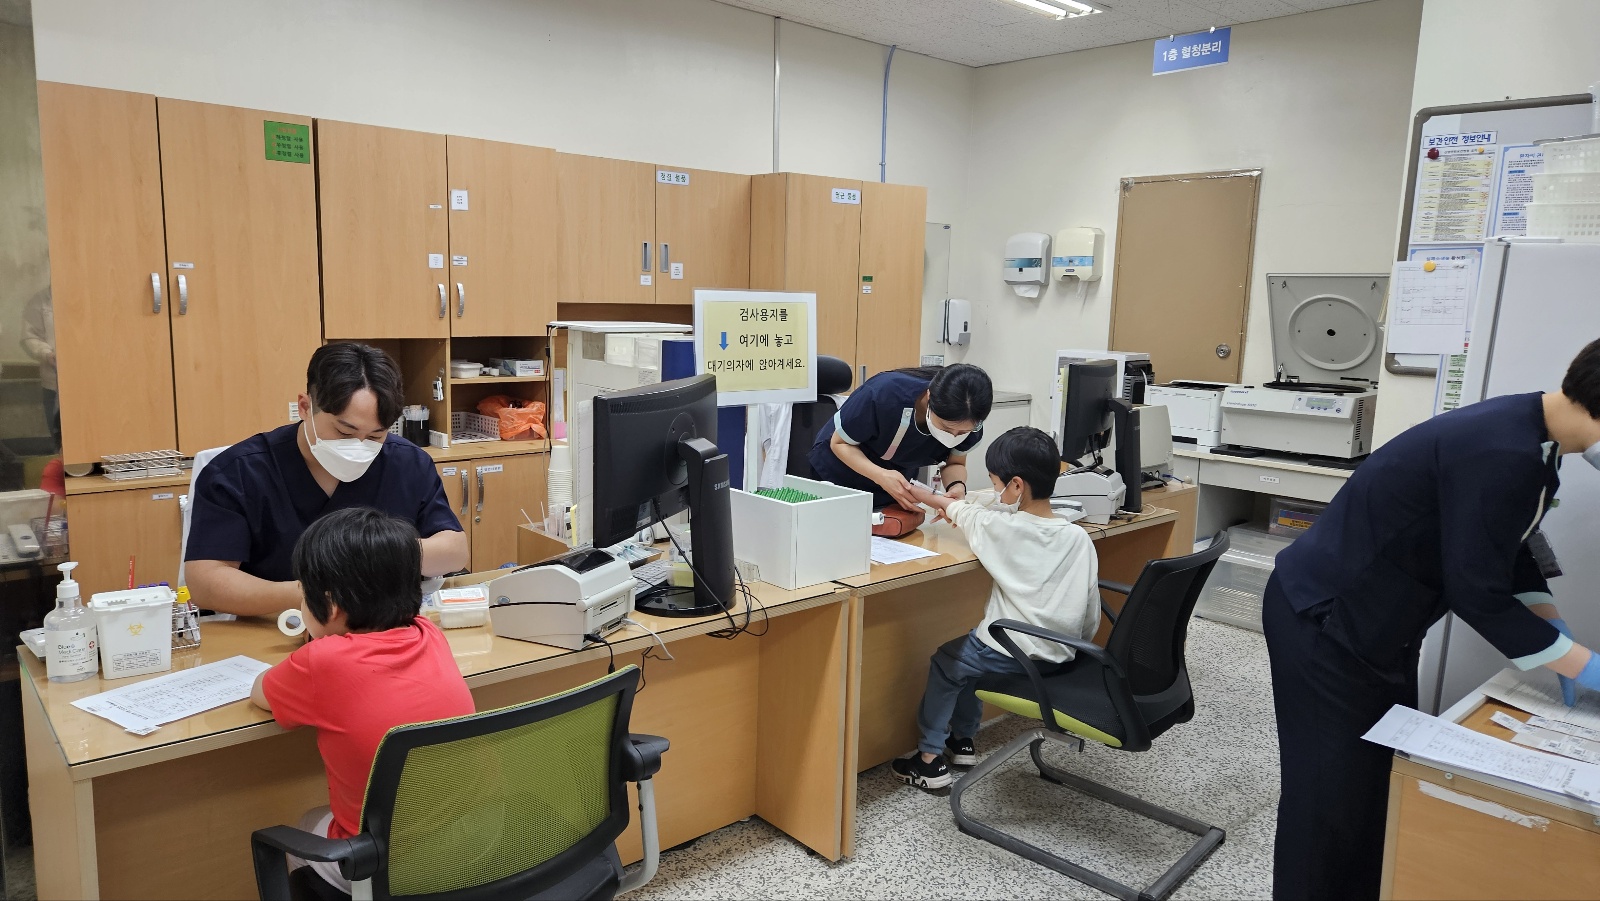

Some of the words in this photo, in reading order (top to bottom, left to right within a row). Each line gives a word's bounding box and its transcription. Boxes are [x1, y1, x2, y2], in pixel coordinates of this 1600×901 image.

[1162, 48, 1178, 61] 1층
[1181, 40, 1222, 59] 혈청분리
[1429, 136, 1458, 146] 보건안전
[1461, 133, 1491, 144] 정보안내
[739, 308, 788, 322] 검사용지를
[739, 333, 769, 347] 여기에
[774, 333, 794, 347] 놓고
[707, 359, 754, 372] 대기의자에
